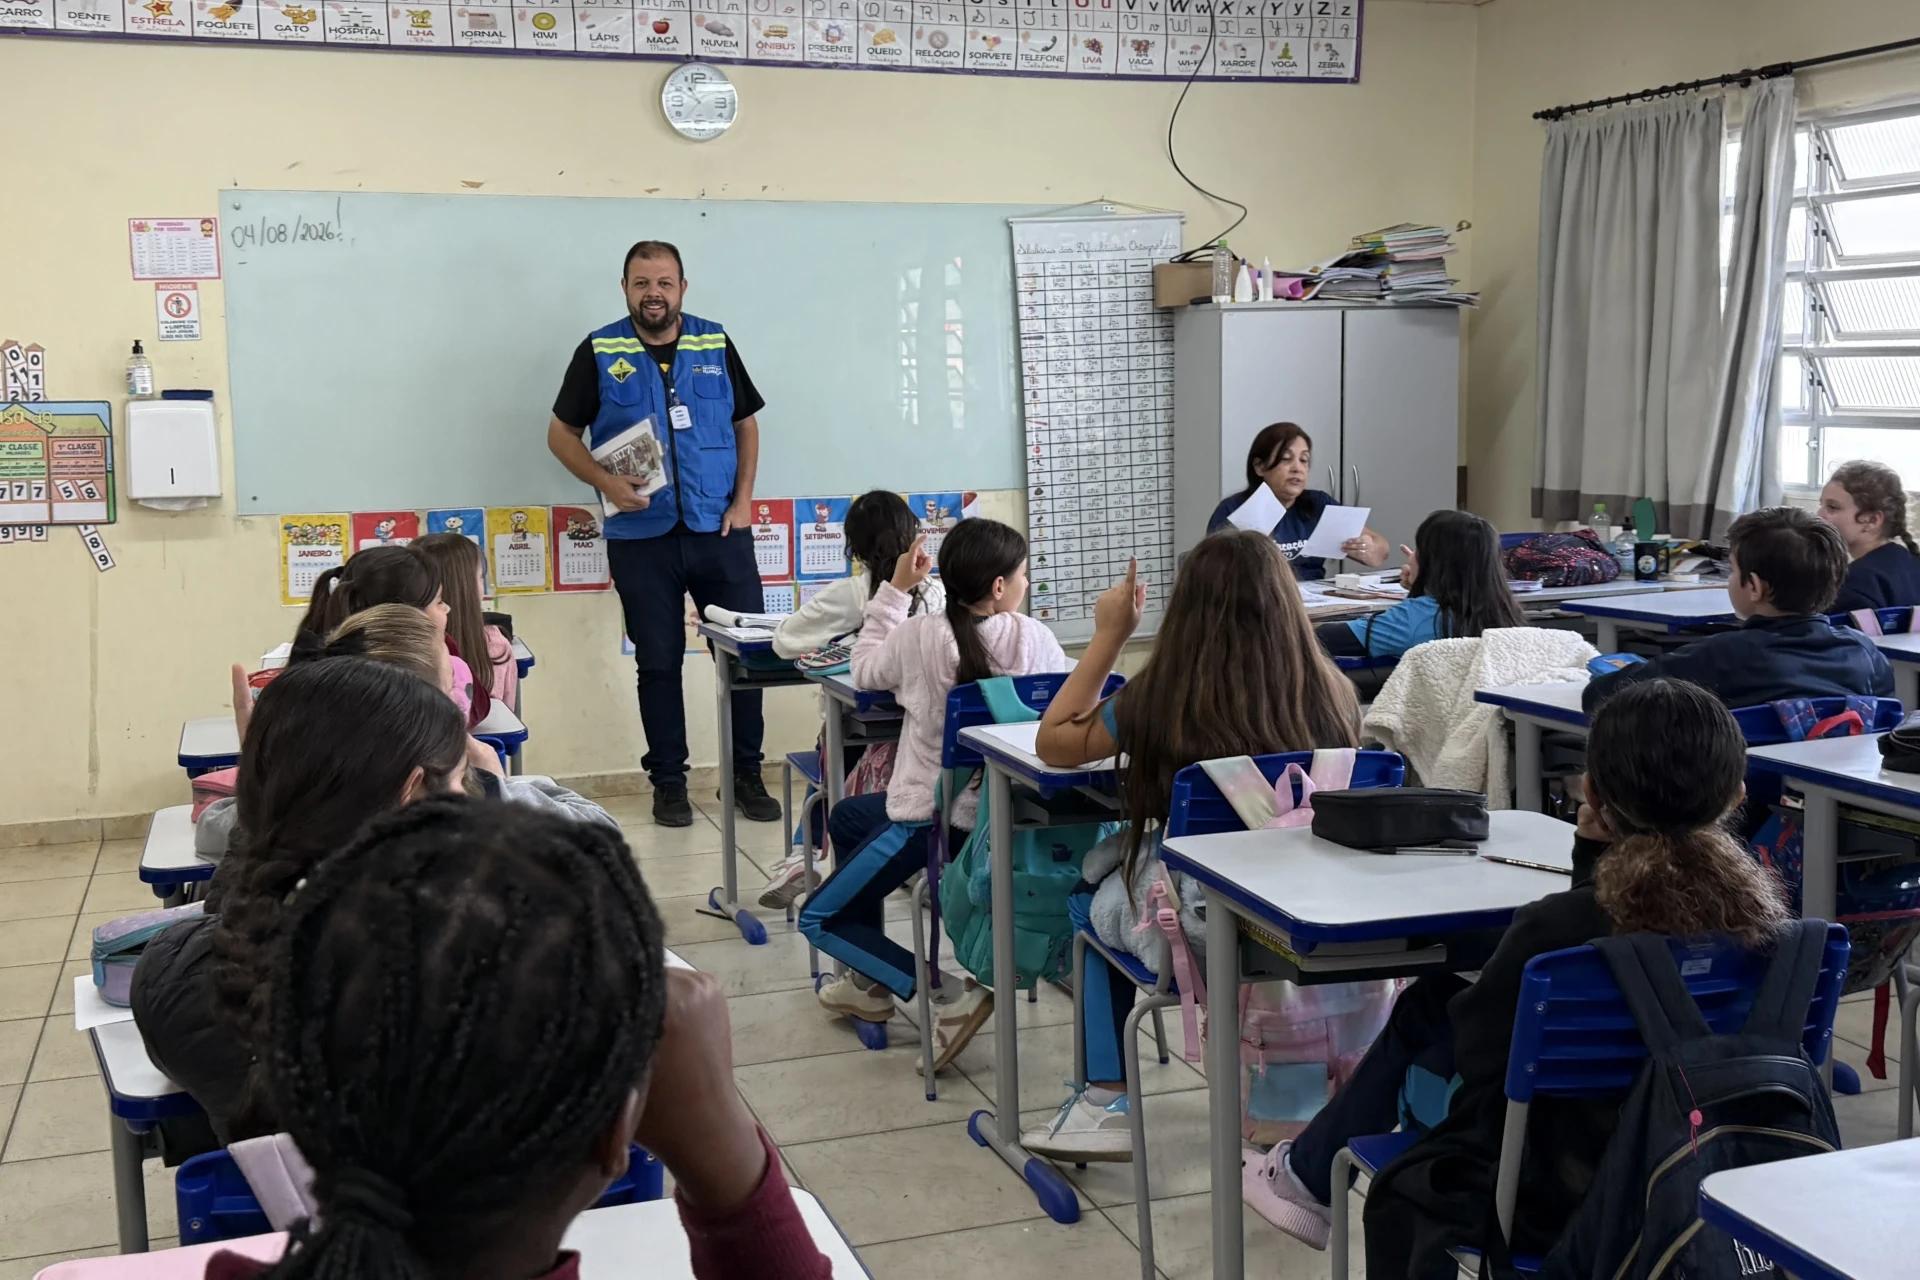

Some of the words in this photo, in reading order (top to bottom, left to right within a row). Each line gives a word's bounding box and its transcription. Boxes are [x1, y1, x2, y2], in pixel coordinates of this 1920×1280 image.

[1170, 0, 1190, 13] W
[1220, 1, 1235, 15] X
[1245, 6, 1256, 15] x
[1271, 2, 1284, 15] Y
[1293, 3, 1304, 15] y
[1317, 2, 1331, 15] Z
[1341, 6, 1351, 16] z
[68, 12, 111, 21] DENTE
[131, 16, 185, 26] ESTRELA
[197, 20, 255, 30] FOGUETE
[274, 24, 310, 33] GATO
[328, 27, 385, 36] HOSPITAL
[533, 31, 558, 39] KIWI
[589, 32, 620, 42] LÁPIS
[701, 39, 739, 48] NUVEM
[808, 44, 854, 53] PRESENTE
[867, 47, 902, 56] QUEIJO
[915, 48, 960, 58] RELÓGIO
[969, 52, 1013, 60] SORVETE
[1020, 54, 1065, 63] TELEFONE
[1082, 56, 1102, 64] UVA
[9, 349, 20, 361] 0
[31, 354, 40, 366] 0
[10, 372, 18, 384] 1
[32, 374, 39, 386] 1
[10, 390, 19, 401] 2
[8, 443, 39, 451] CLASSE
[67, 443, 97, 451] CLASSE
[14, 485, 24, 496] 7
[33, 486, 43, 498] 7
[62, 486, 73, 499] 5
[85, 487, 96, 499] 8
[1, 527, 10, 539] 9
[35, 526, 44, 537] 9
[804, 532, 842, 540] SETEMBRO
[89, 537, 100, 549] 8
[574, 541, 594, 549] MAIO
[98, 553, 109, 566] 9
